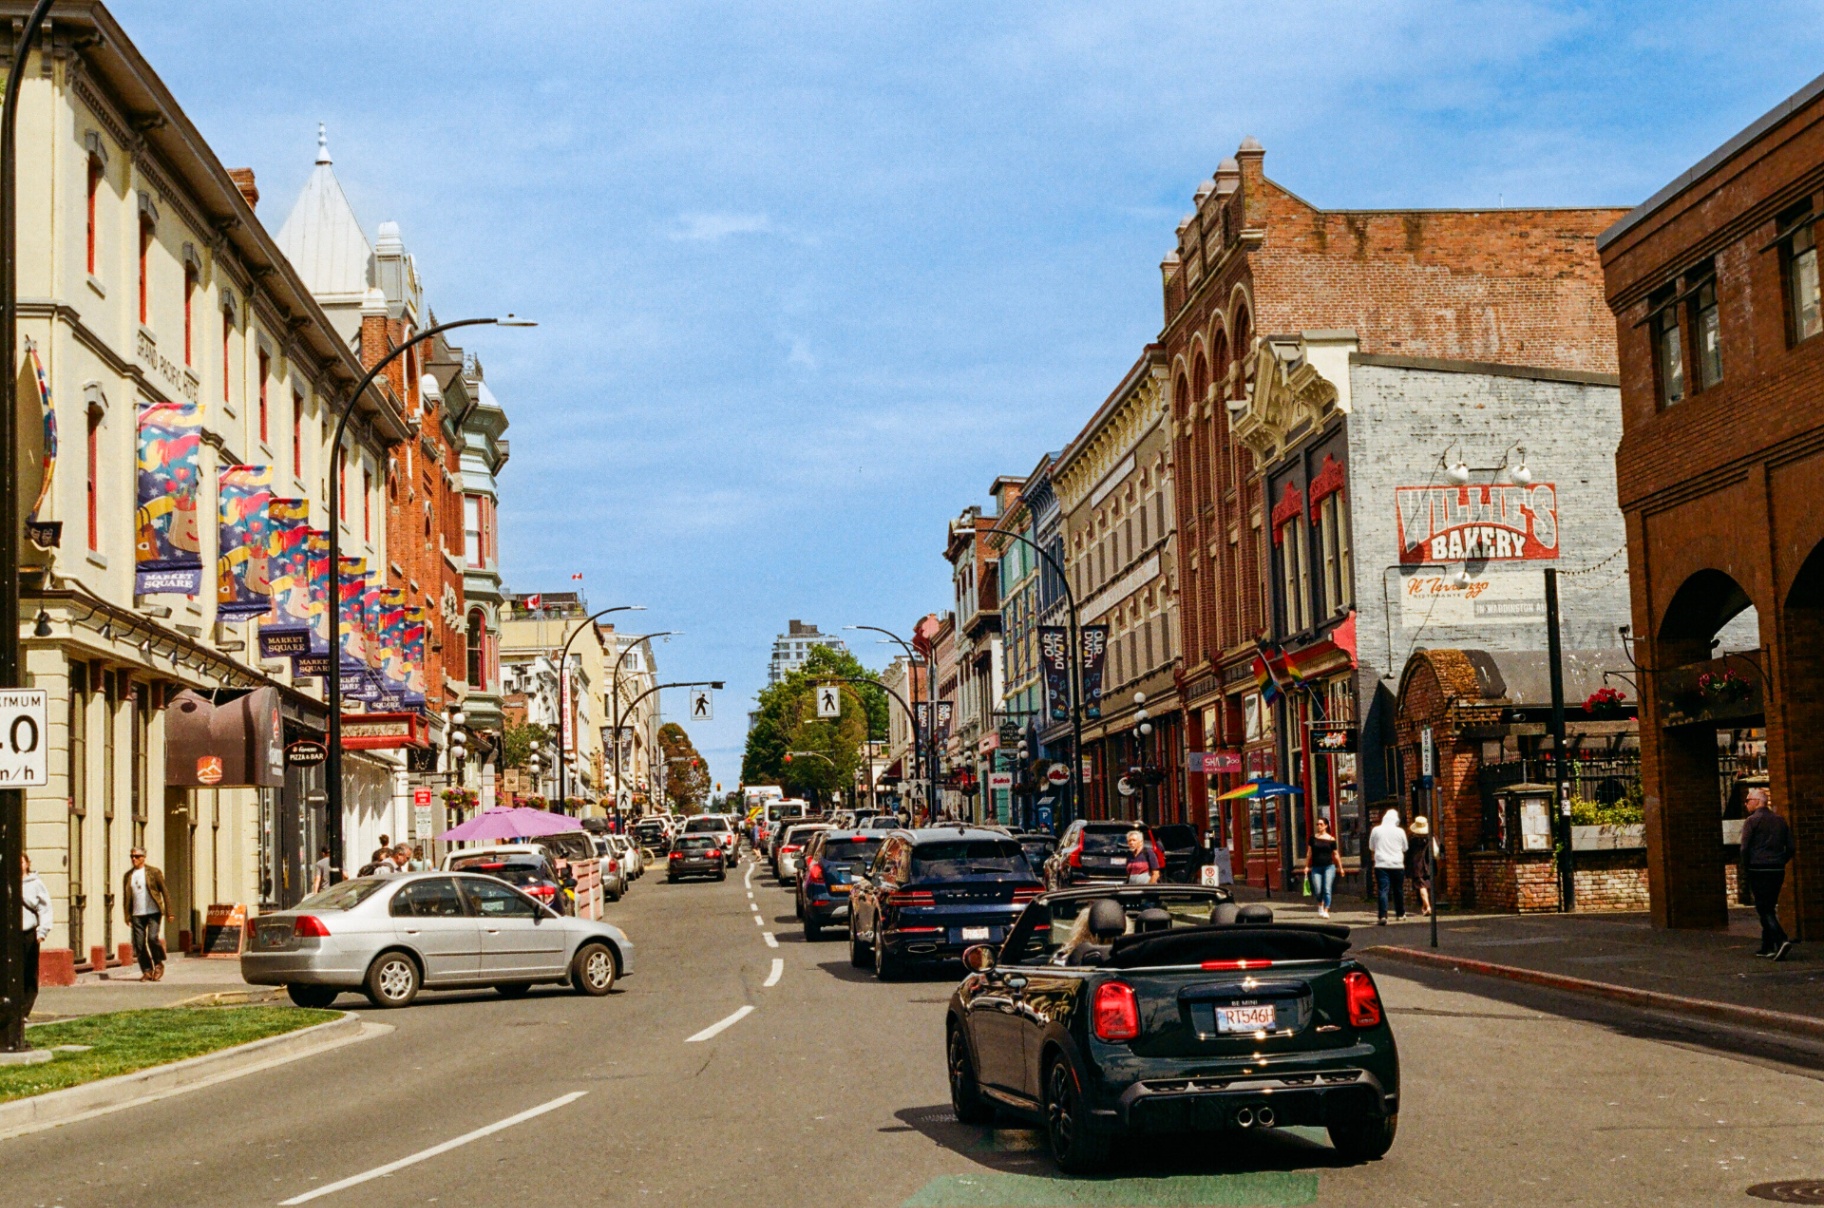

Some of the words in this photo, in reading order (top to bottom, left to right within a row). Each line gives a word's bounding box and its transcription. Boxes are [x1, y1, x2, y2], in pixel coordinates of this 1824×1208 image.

[1398, 484, 1557, 553] WILLIE'S
[1431, 526, 1527, 560] BAKERY
[143, 580, 194, 589] SQUARE
[145, 573, 194, 581] MARKET
[268, 644, 305, 653] SQUARE
[1044, 633, 1054, 657] OUR
[1054, 633, 1065, 670] DWTN
[1084, 631, 1094, 668] DWTN
[1094, 630, 1104, 655] OUR
[0, 714, 39, 754] 0
[1225, 1008, 1276, 1024] RT546H
